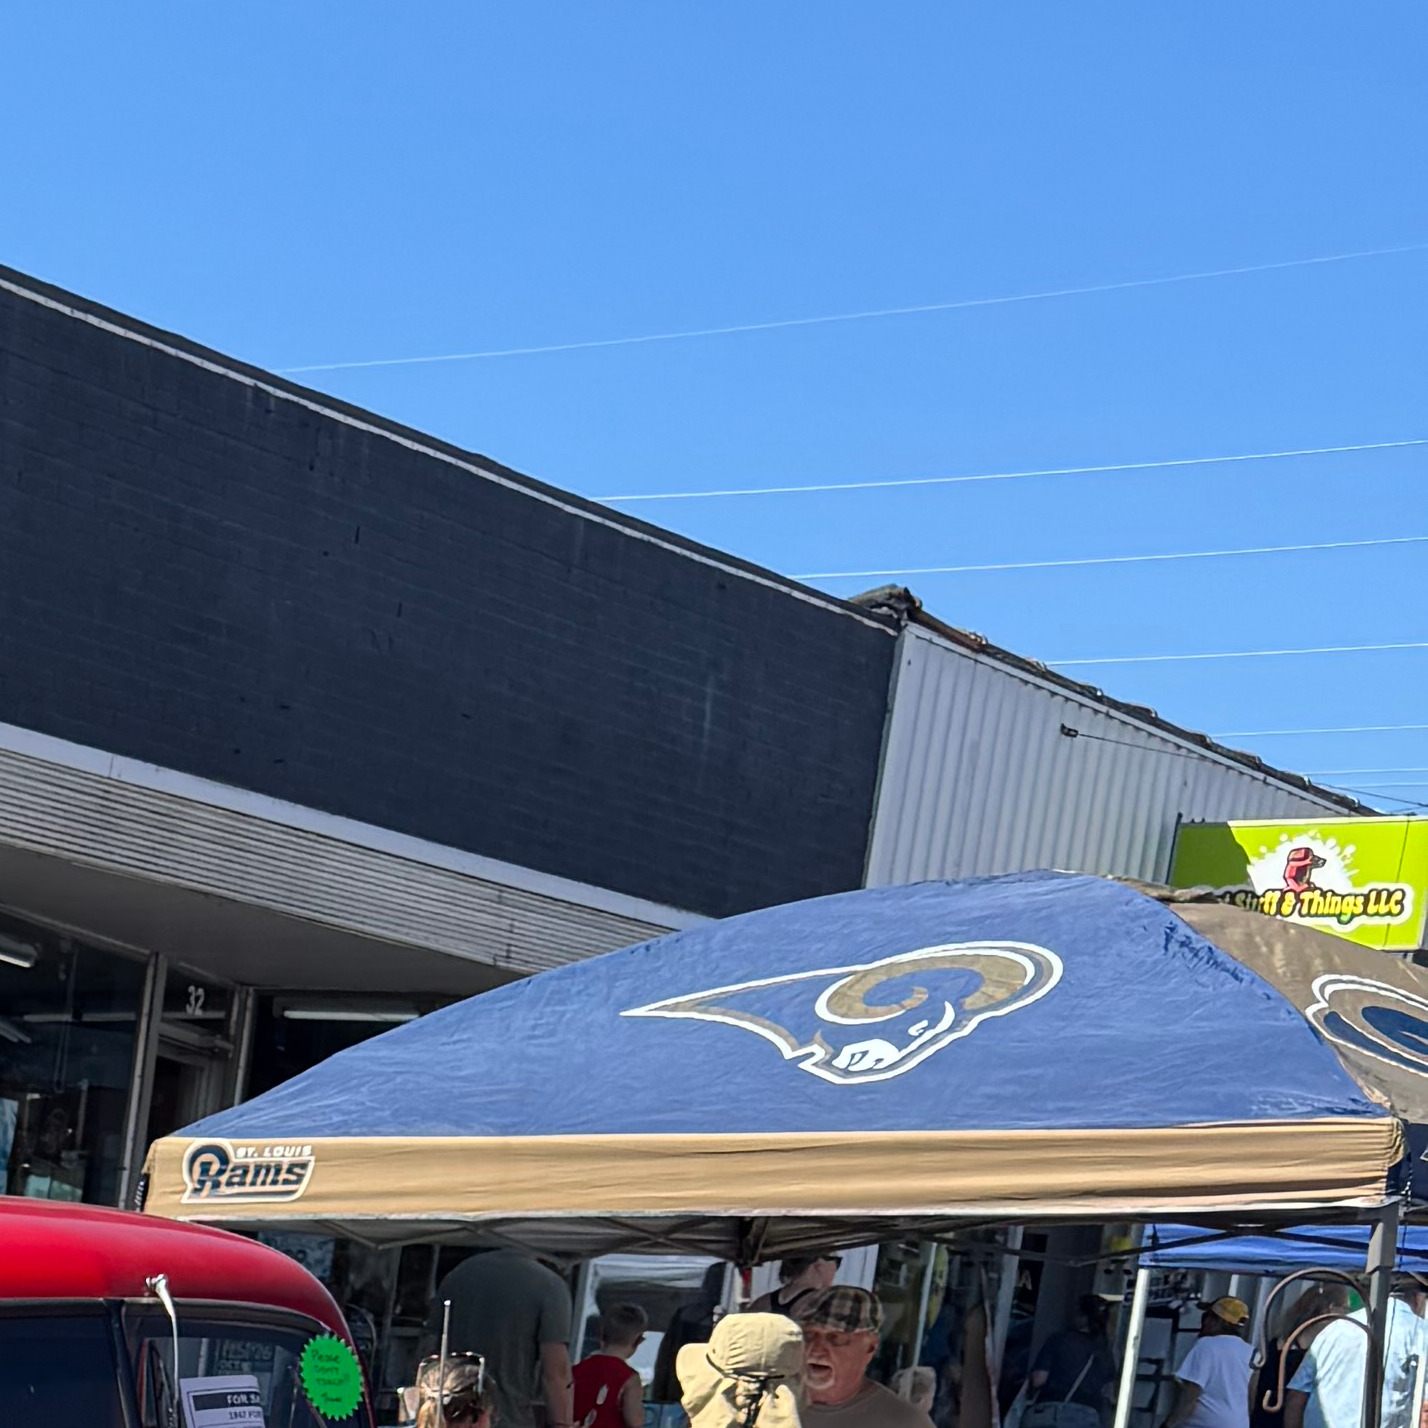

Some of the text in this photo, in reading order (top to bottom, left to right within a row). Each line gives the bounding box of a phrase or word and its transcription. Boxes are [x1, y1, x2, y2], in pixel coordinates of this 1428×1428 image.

[1281, 890, 1296, 915] &
[1299, 889, 1364, 924] Things
[1367, 889, 1404, 914] LLC
[186, 985, 204, 1016] 32
[236, 1144, 312, 1158] ST. LOUIS
[189, 1144, 309, 1196] Rams
[250, 1393, 261, 1404] SA
